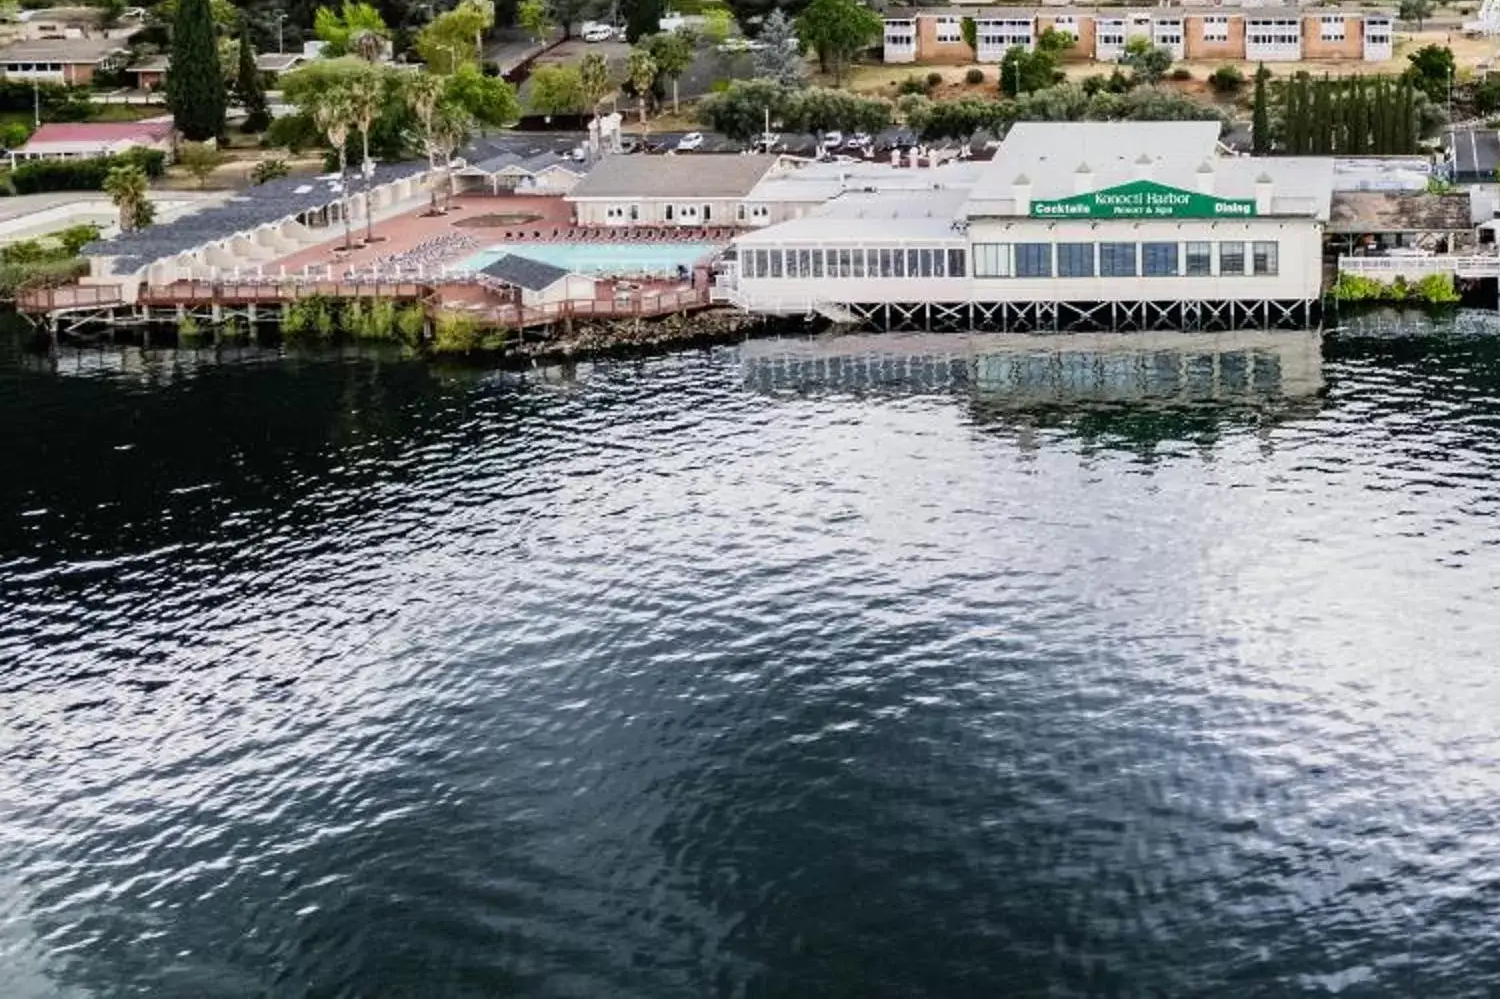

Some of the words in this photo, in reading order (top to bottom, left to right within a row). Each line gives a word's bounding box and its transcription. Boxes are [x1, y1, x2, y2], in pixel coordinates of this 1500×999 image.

[1095, 192, 1142, 204] Konocti
[1147, 192, 1191, 204] Harbor
[1035, 203, 1091, 214] Cocktails
[1145, 206, 1152, 214] &
[1155, 206, 1173, 216] Spa
[1215, 202, 1251, 214] Dining
